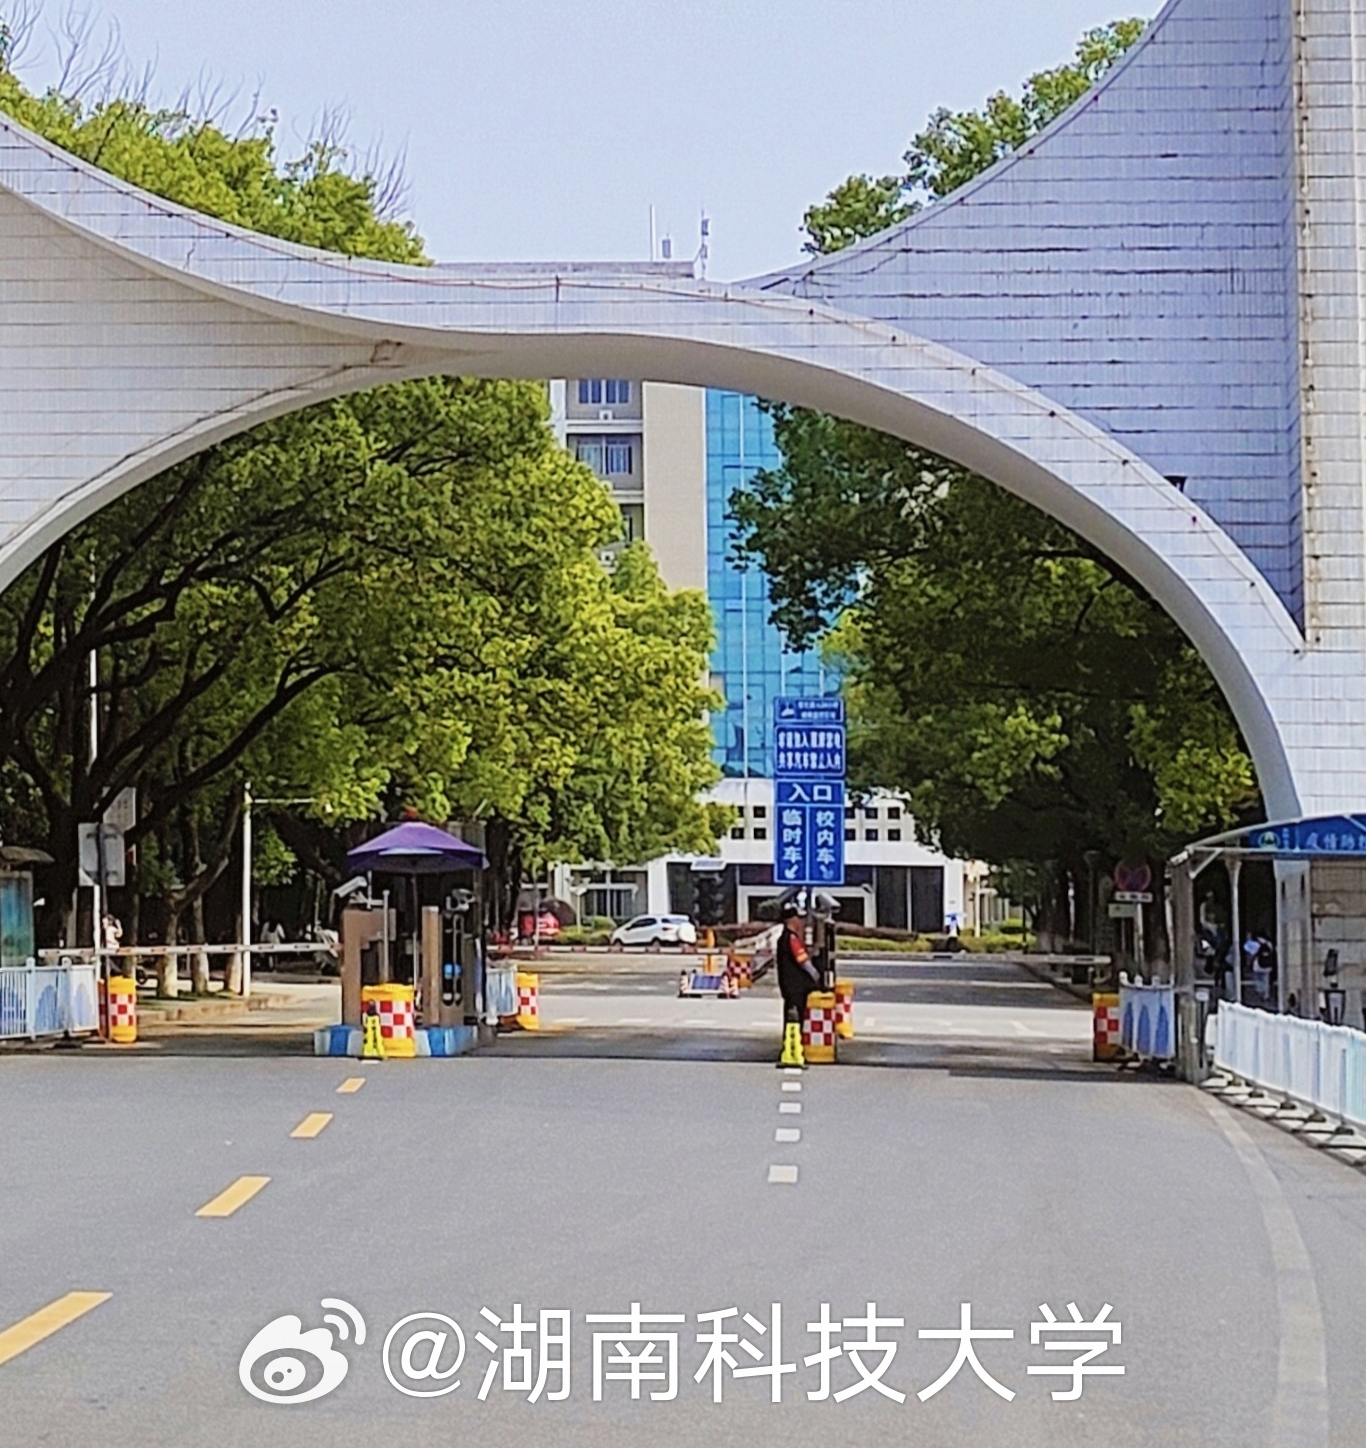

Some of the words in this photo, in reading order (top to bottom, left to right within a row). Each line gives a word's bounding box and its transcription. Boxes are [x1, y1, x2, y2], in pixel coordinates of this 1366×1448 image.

[788, 783, 832, 802] 入口
[782, 808, 803, 864] 临时车
[816, 810, 836, 864] 校内车
